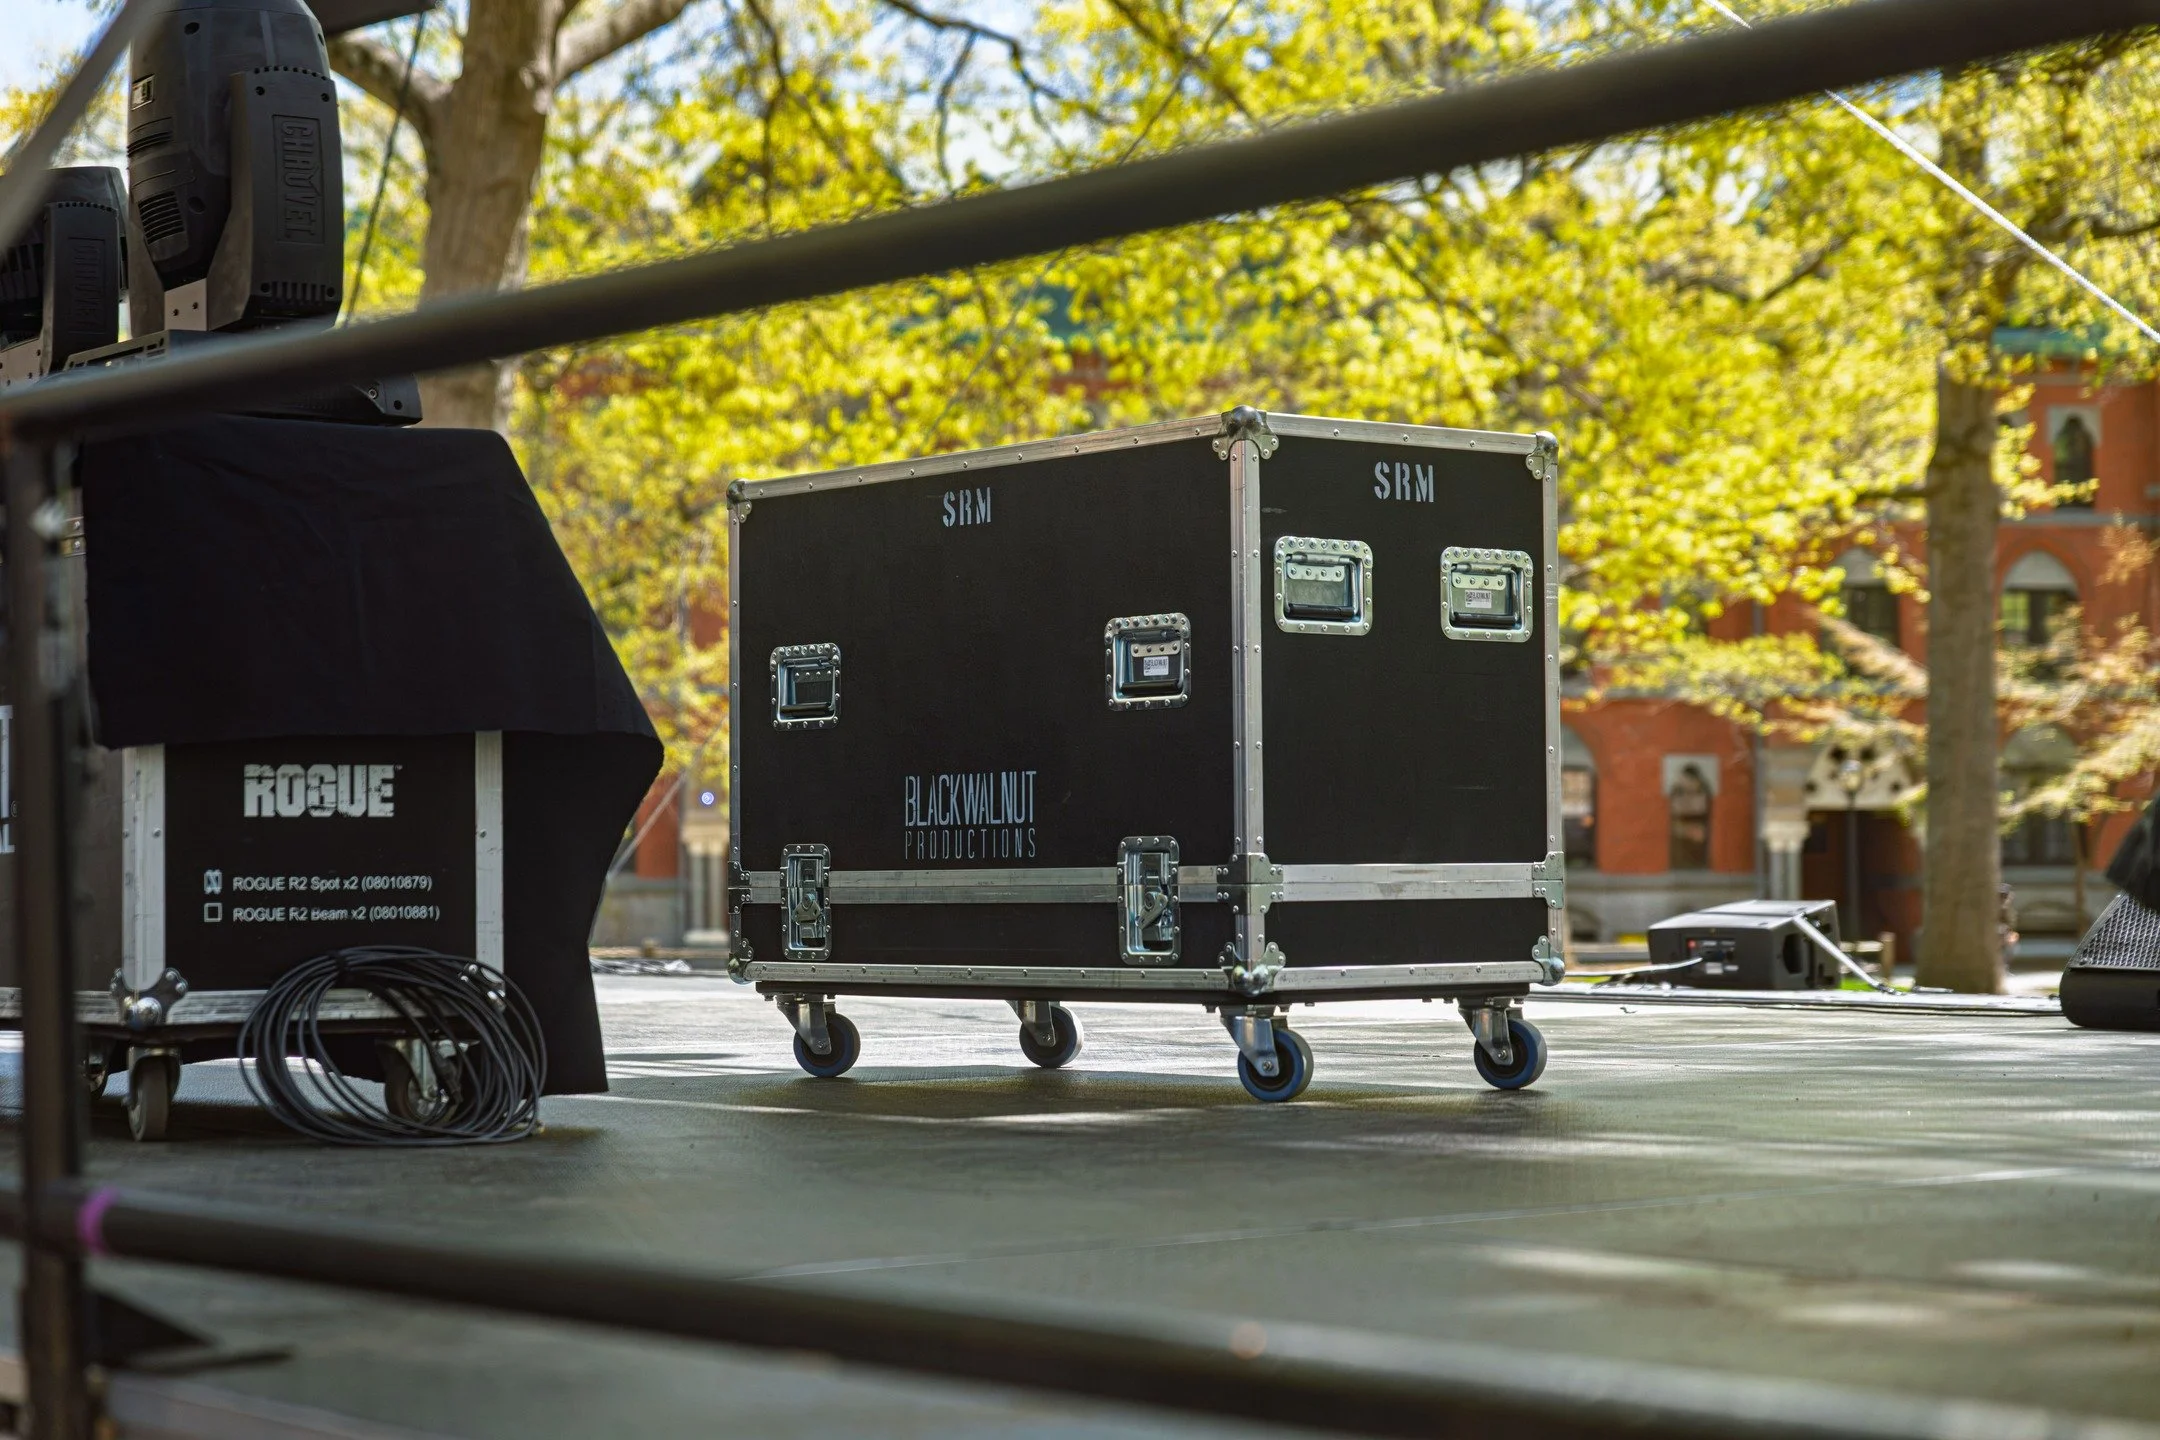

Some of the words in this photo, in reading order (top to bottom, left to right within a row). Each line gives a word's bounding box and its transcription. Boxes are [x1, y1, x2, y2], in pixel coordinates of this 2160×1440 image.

[281, 120, 320, 237] CHAUVET
[1374, 461, 1434, 503] SRM
[942, 486, 991, 528] SRM
[243, 763, 395, 818] ROGUE
[905, 771, 1037, 827] BLACKWALNUT
[905, 828, 1036, 860] PRODUCTIONS
[232, 876, 286, 891] ROGUE
[288, 876, 308, 891] R2
[310, 876, 341, 894] Spot
[343, 876, 359, 890] x2
[361, 874, 433, 893] (08010879)
[232, 907, 286, 922] ROGUE
[288, 907, 308, 922] R2
[310, 906, 348, 921] Beam
[351, 906, 367, 921] x2
[369, 905, 440, 923] (08010881)
